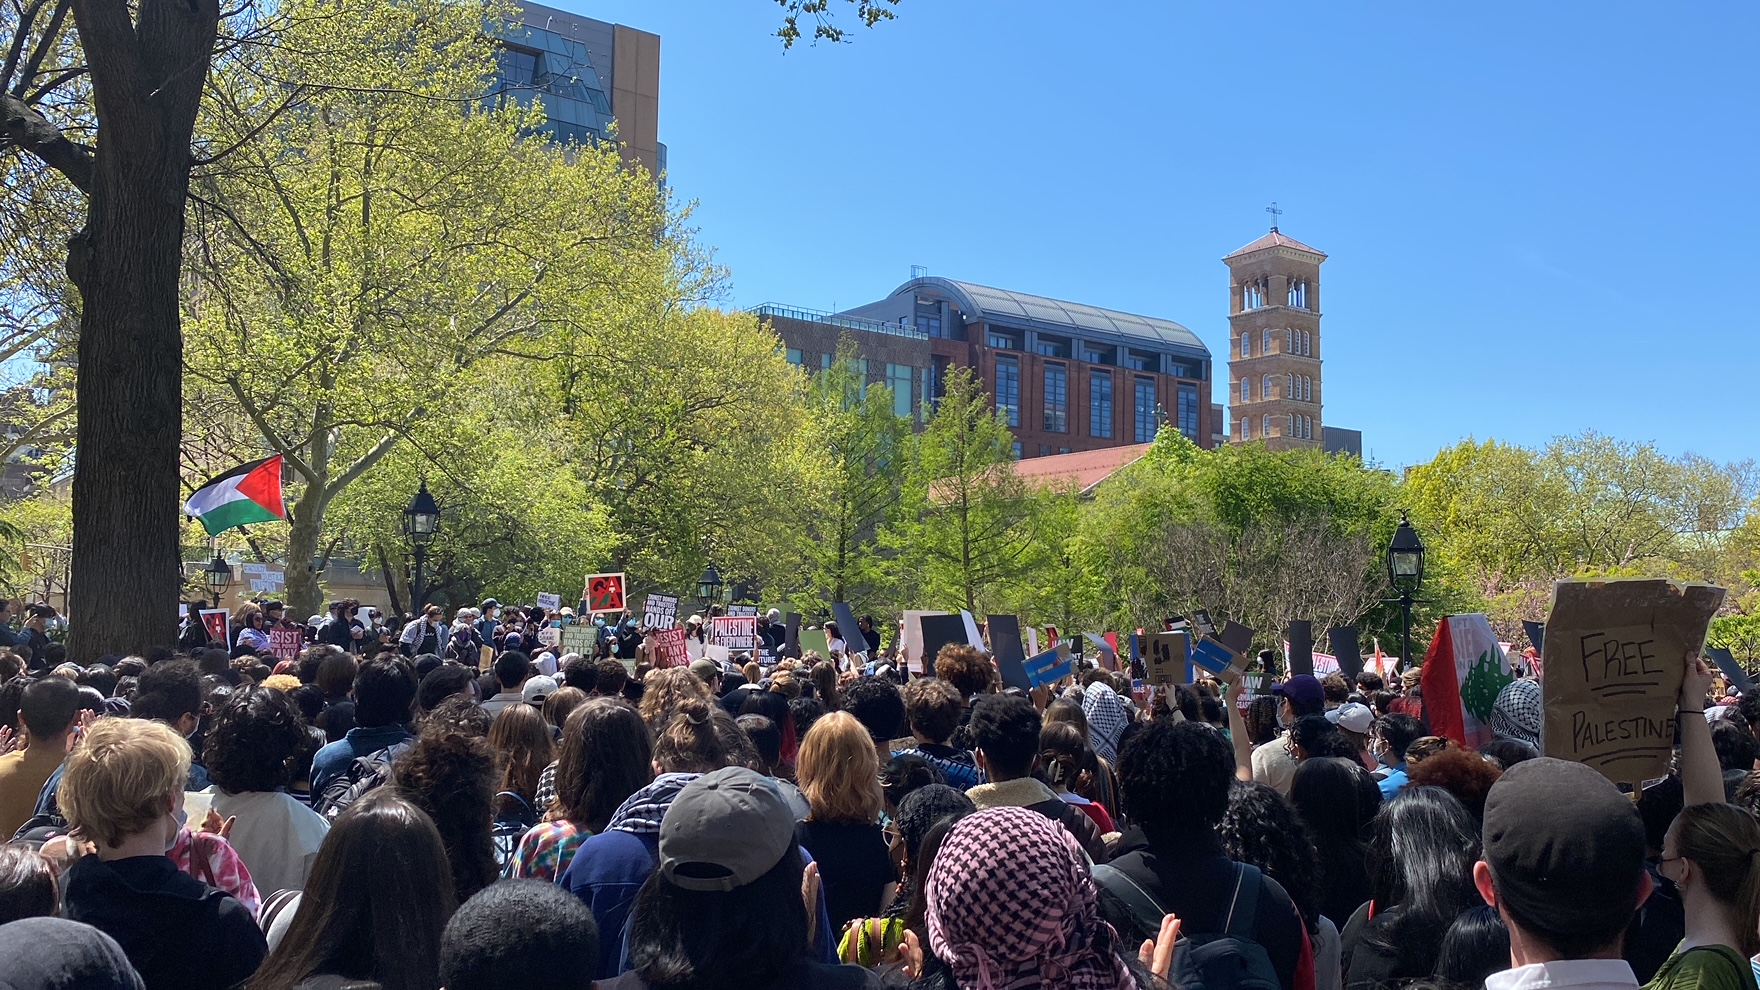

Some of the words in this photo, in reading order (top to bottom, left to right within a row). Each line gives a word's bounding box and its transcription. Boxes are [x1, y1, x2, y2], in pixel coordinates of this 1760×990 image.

[645, 605, 665, 615] HANDS
[665, 608, 676, 616] OFF
[644, 612, 675, 631] OUR
[715, 619, 753, 636] PALESTINE
[271, 631, 298, 643] ESIST
[563, 638, 584, 647] HANDS
[583, 639, 595, 648] OFF
[721, 637, 753, 647] EVERYWHERE
[668, 644, 686, 657] ANY
[1580, 632, 1664, 682] FREE
[1572, 710, 1677, 753] PALESTINE
